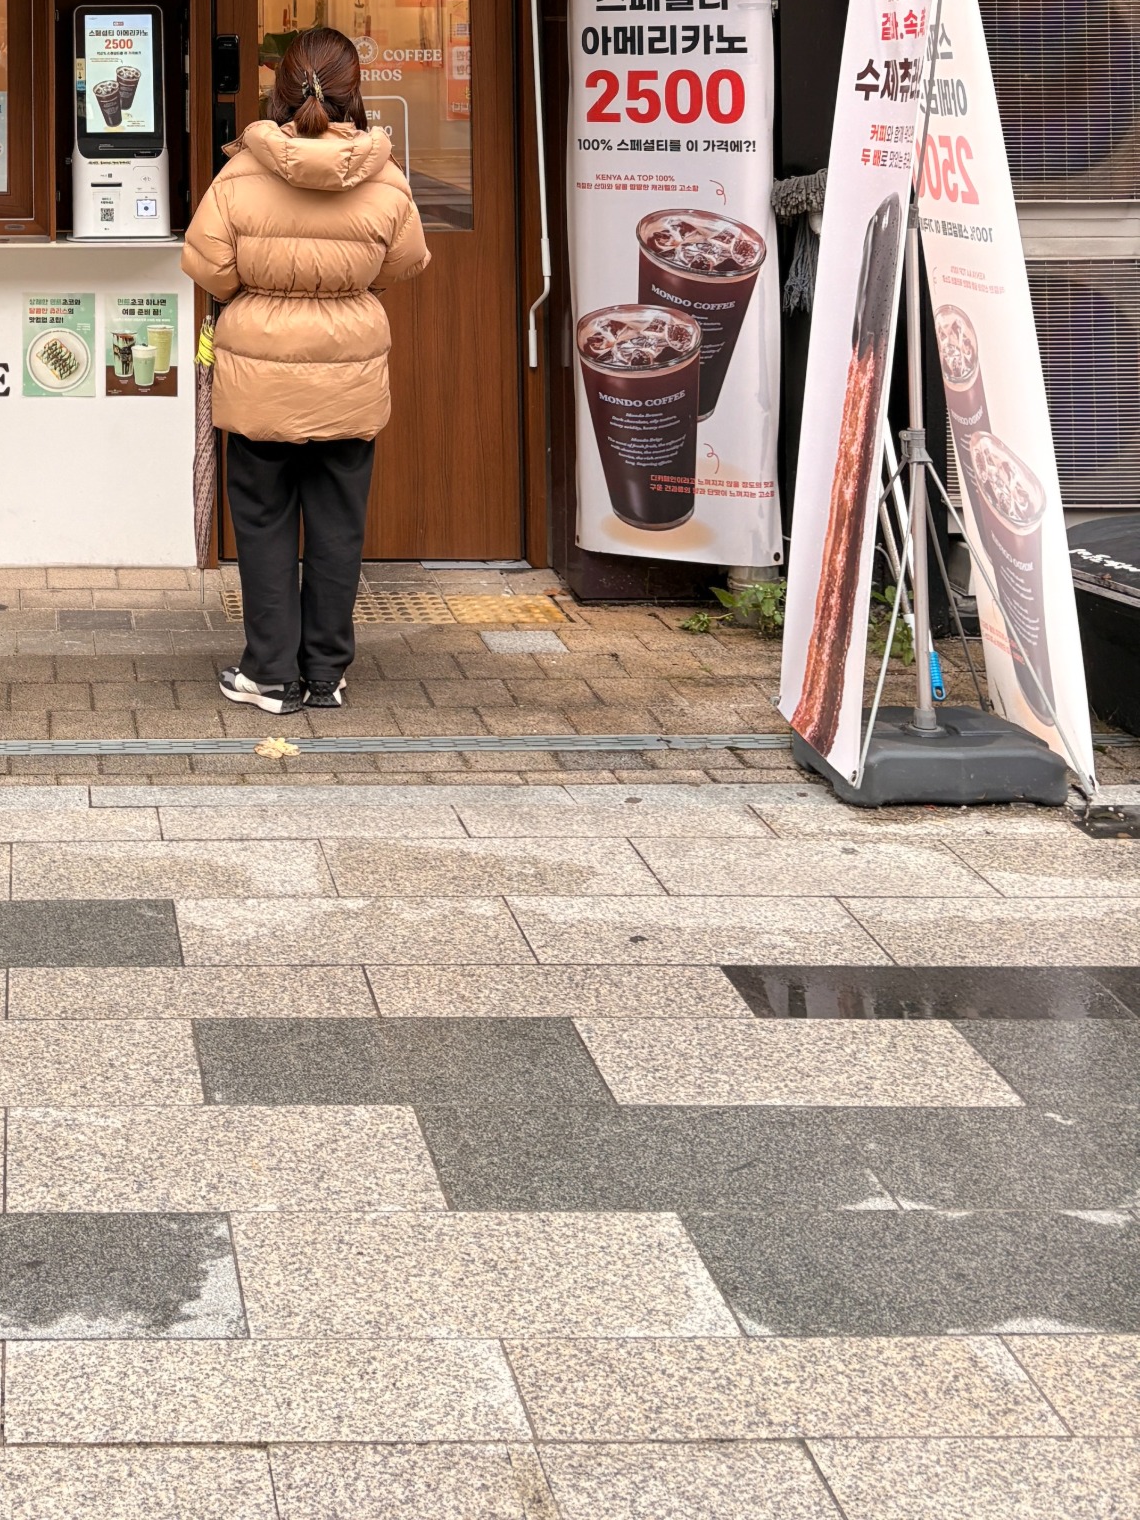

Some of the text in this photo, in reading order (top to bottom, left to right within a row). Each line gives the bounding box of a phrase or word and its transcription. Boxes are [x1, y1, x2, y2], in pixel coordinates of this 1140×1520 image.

[105, 38, 134, 49] 2500
[581, 25, 748, 56] 아메리카노
[383, 49, 443, 62] COFFEE
[360, 68, 403, 82] RROS
[585, 68, 746, 125] 2500
[365, 110, 381, 120] EN
[577, 138, 757, 154] 100% 스페셜티를 이 가격에?!
[595, 173, 622, 181] KENYA
[624, 174, 636, 182] AA
[637, 174, 654, 182] TOP
[650, 283, 736, 311] MONDO COFFEE
[598, 389, 686, 407] MONDO COFFEE
